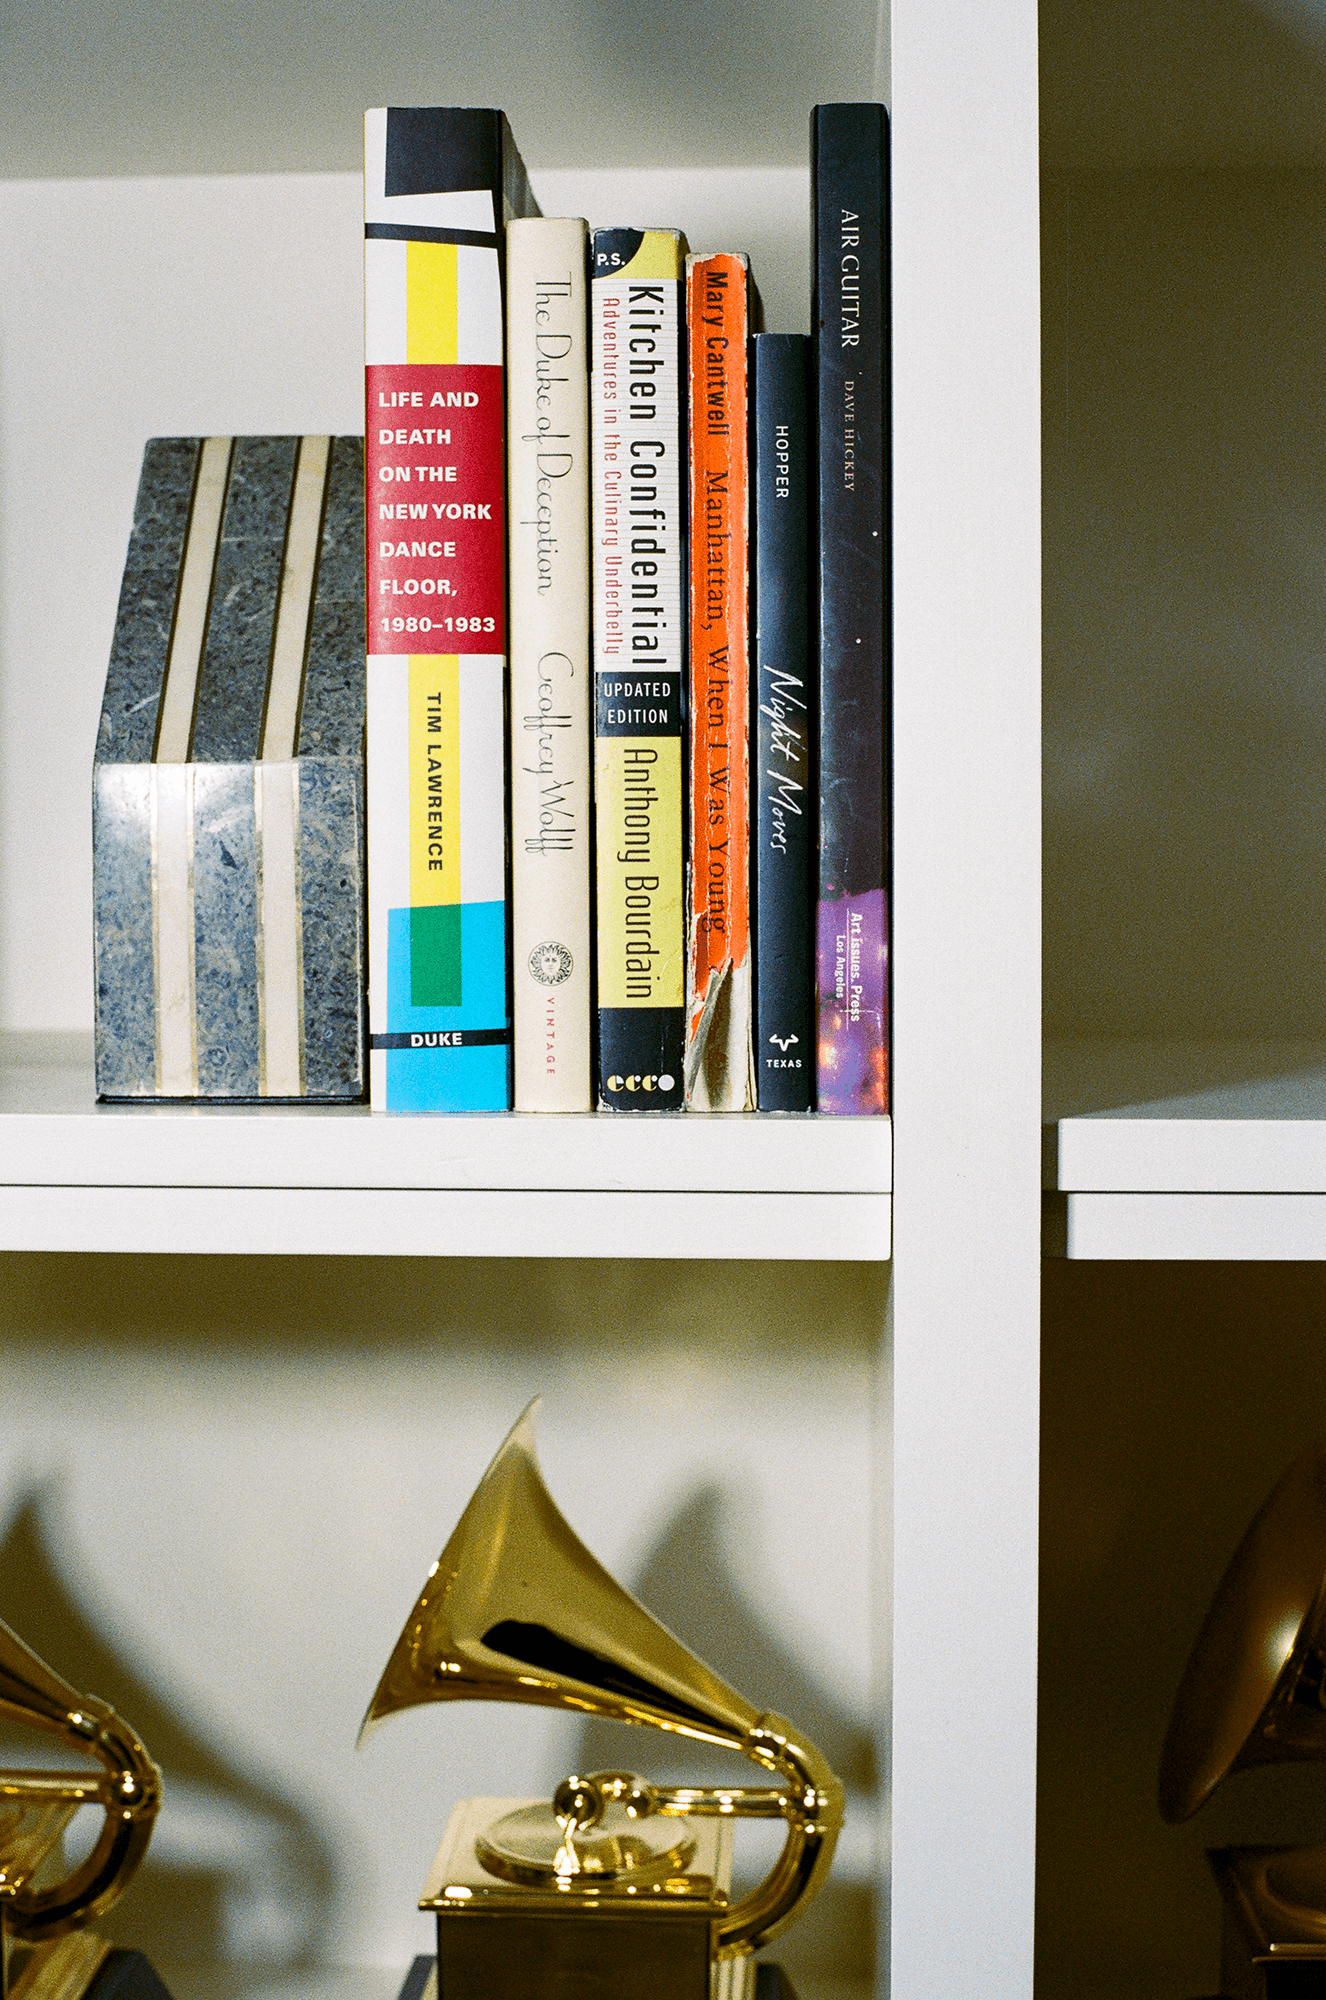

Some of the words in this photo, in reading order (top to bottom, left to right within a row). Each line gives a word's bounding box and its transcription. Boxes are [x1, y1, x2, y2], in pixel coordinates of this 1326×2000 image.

[841, 208, 859, 248] AIR
[597, 253, 625, 266] P.S.
[535, 271, 572, 329] The
[702, 271, 728, 327] Mary
[841, 255, 860, 347] GUITAR
[535, 334, 572, 407] Duke
[602, 298, 620, 400] Adventures
[629, 286, 664, 420] Kitchen
[379, 393, 422, 407] LIFE
[430, 392, 478, 407] AND
[705, 335, 730, 435] Cantwell
[845, 381, 854, 423] DAVE
[379, 429, 451, 444] DEATH
[521, 417, 569, 445] of
[604, 409, 620, 425] in
[379, 467, 410, 482] ON
[415, 467, 457, 482] THE
[604, 432, 620, 461] the
[776, 425, 788, 498] HOPPER
[845, 429, 855, 490] HICKEY
[379, 504, 427, 519] NEW
[432, 504, 491, 519] YORK
[521, 453, 573, 597] Deception
[601, 471, 621, 546] Culinary
[380, 542, 455, 557] DANCE
[630, 441, 667, 664] Confidential
[701, 469, 732, 631] Manhattan,
[380, 579, 457, 596] FLOOR,
[602, 555, 622, 656] Underbelly
[427, 693, 441, 733] TIM
[523, 651, 573, 776] Geoffrey
[604, 682, 671, 697] UPDATED
[708, 646, 731, 728] When
[759, 664, 807, 761] Night
[608, 709, 668, 724] EDITION
[428, 744, 443, 871] LAWRENCE
[525, 780, 576, 856] Wolff
[617, 748, 658, 863] Anthony
[709, 766, 730, 825] Was
[767, 769, 803, 854] Moves
[702, 839, 730, 933] Young
[625, 876, 662, 998] Bourdain
[836, 935, 846, 953] Los
[850, 913, 863, 934] Art
[834, 957, 846, 999] Angeles
[850, 985, 863, 1022] Press
[411, 1032, 462, 1047] DUKE
[547, 997, 555, 1076] VINTAGE
[766, 1059, 801, 1068] TEXAS
